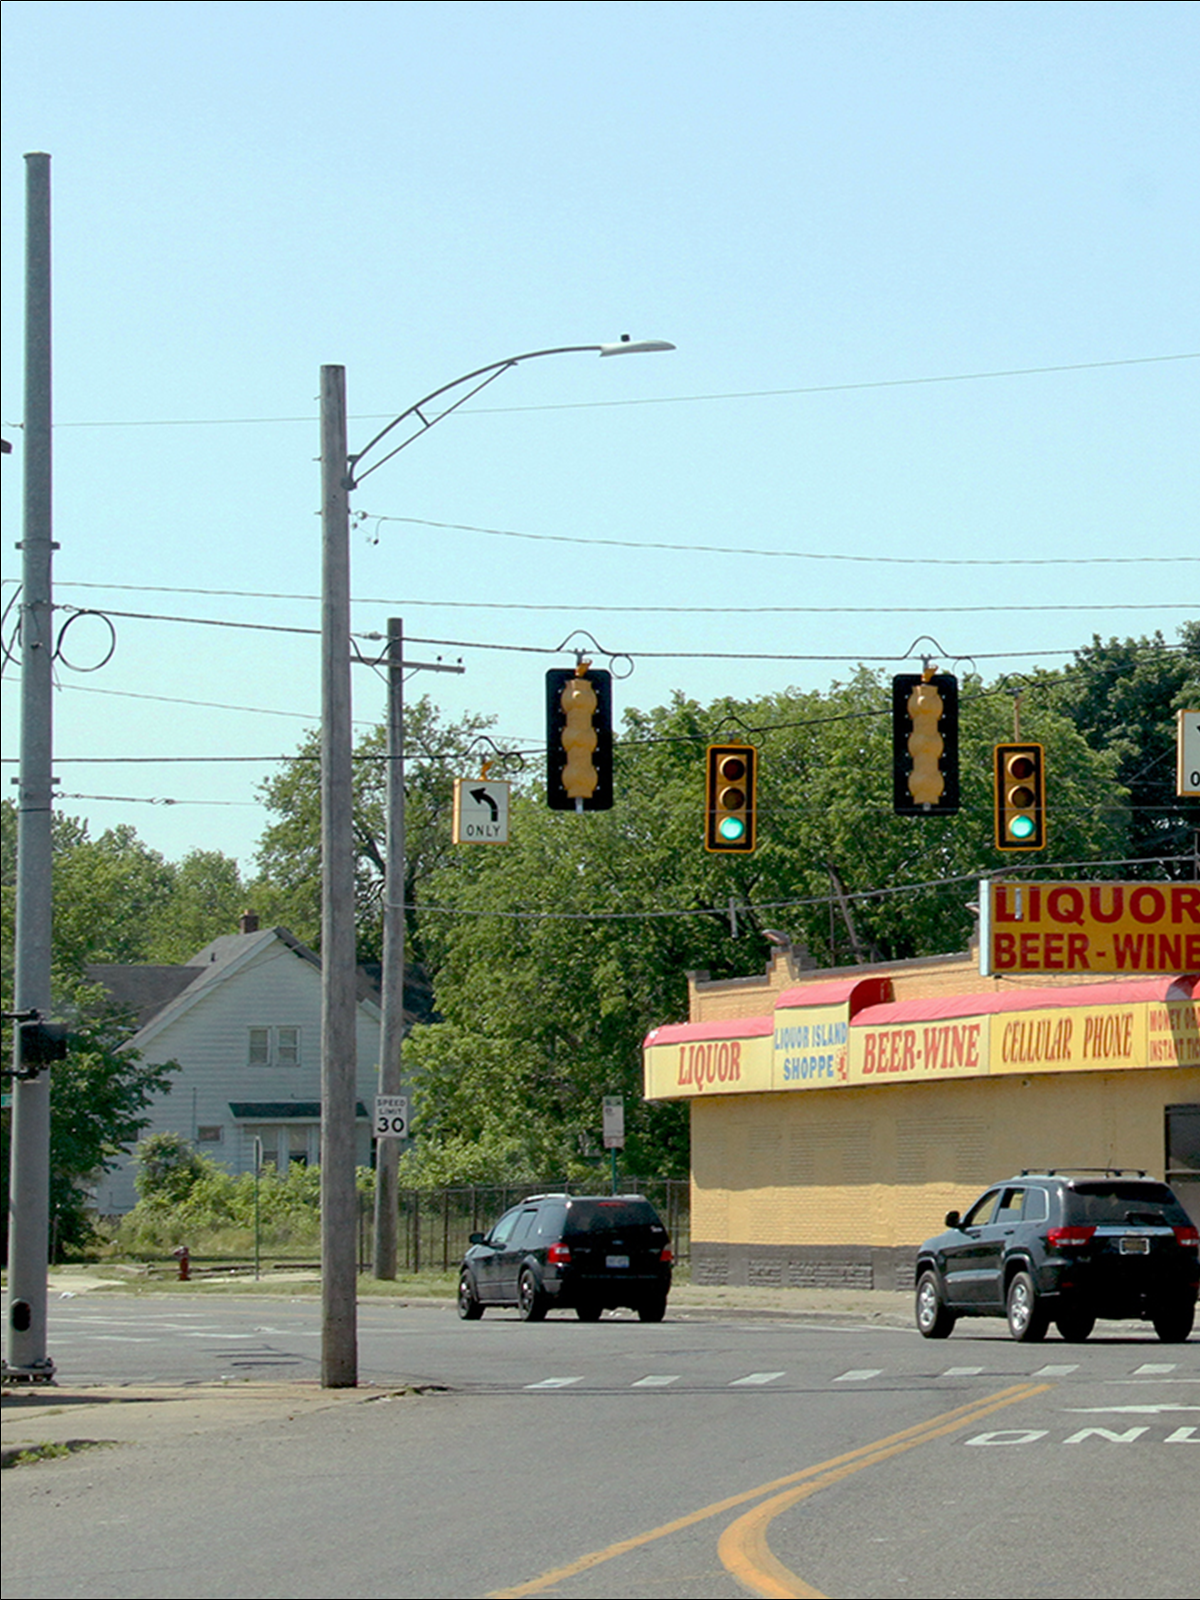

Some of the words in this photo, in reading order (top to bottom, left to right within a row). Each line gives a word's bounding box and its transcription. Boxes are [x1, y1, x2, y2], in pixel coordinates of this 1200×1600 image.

[466, 824, 500, 837] ONLY
[1149, 1008, 1181, 1032] MONEY
[774, 1025, 809, 1053] LIQUOR
[812, 1022, 847, 1047] ISLAND
[861, 1023, 981, 1075] BEER-WINE
[1001, 1017, 1073, 1063] CELLULAR
[1082, 1013, 1135, 1059] PHONE
[1149, 1038, 1185, 1062] INSTANT
[677, 1041, 742, 1092] LIQUOR
[783, 1054, 834, 1081] SHOPPE
[376, 1099, 406, 1107] SPEED
[377, 1117, 405, 1133] 30
